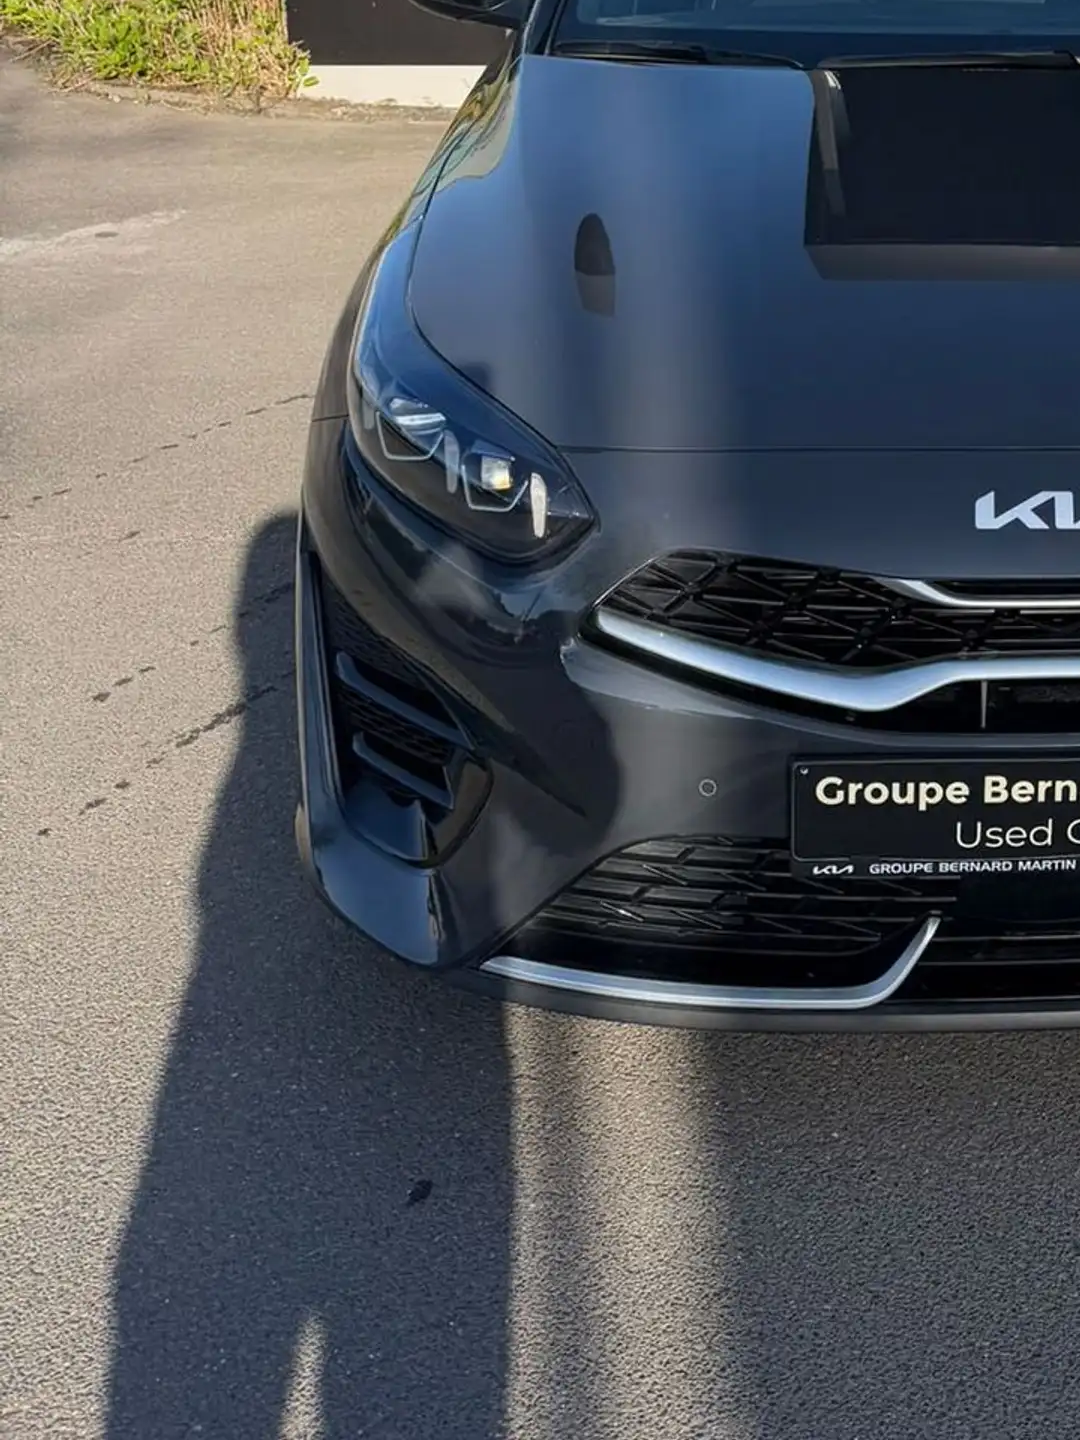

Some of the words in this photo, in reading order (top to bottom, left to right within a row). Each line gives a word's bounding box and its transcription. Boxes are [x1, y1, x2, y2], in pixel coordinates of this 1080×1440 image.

[815, 776, 971, 811] Groupe
[956, 818, 1053, 849] Used
[869, 863, 934, 875] GROUPE
[939, 861, 1013, 874] BERNARD
[1018, 859, 1077, 872] MARTIN
